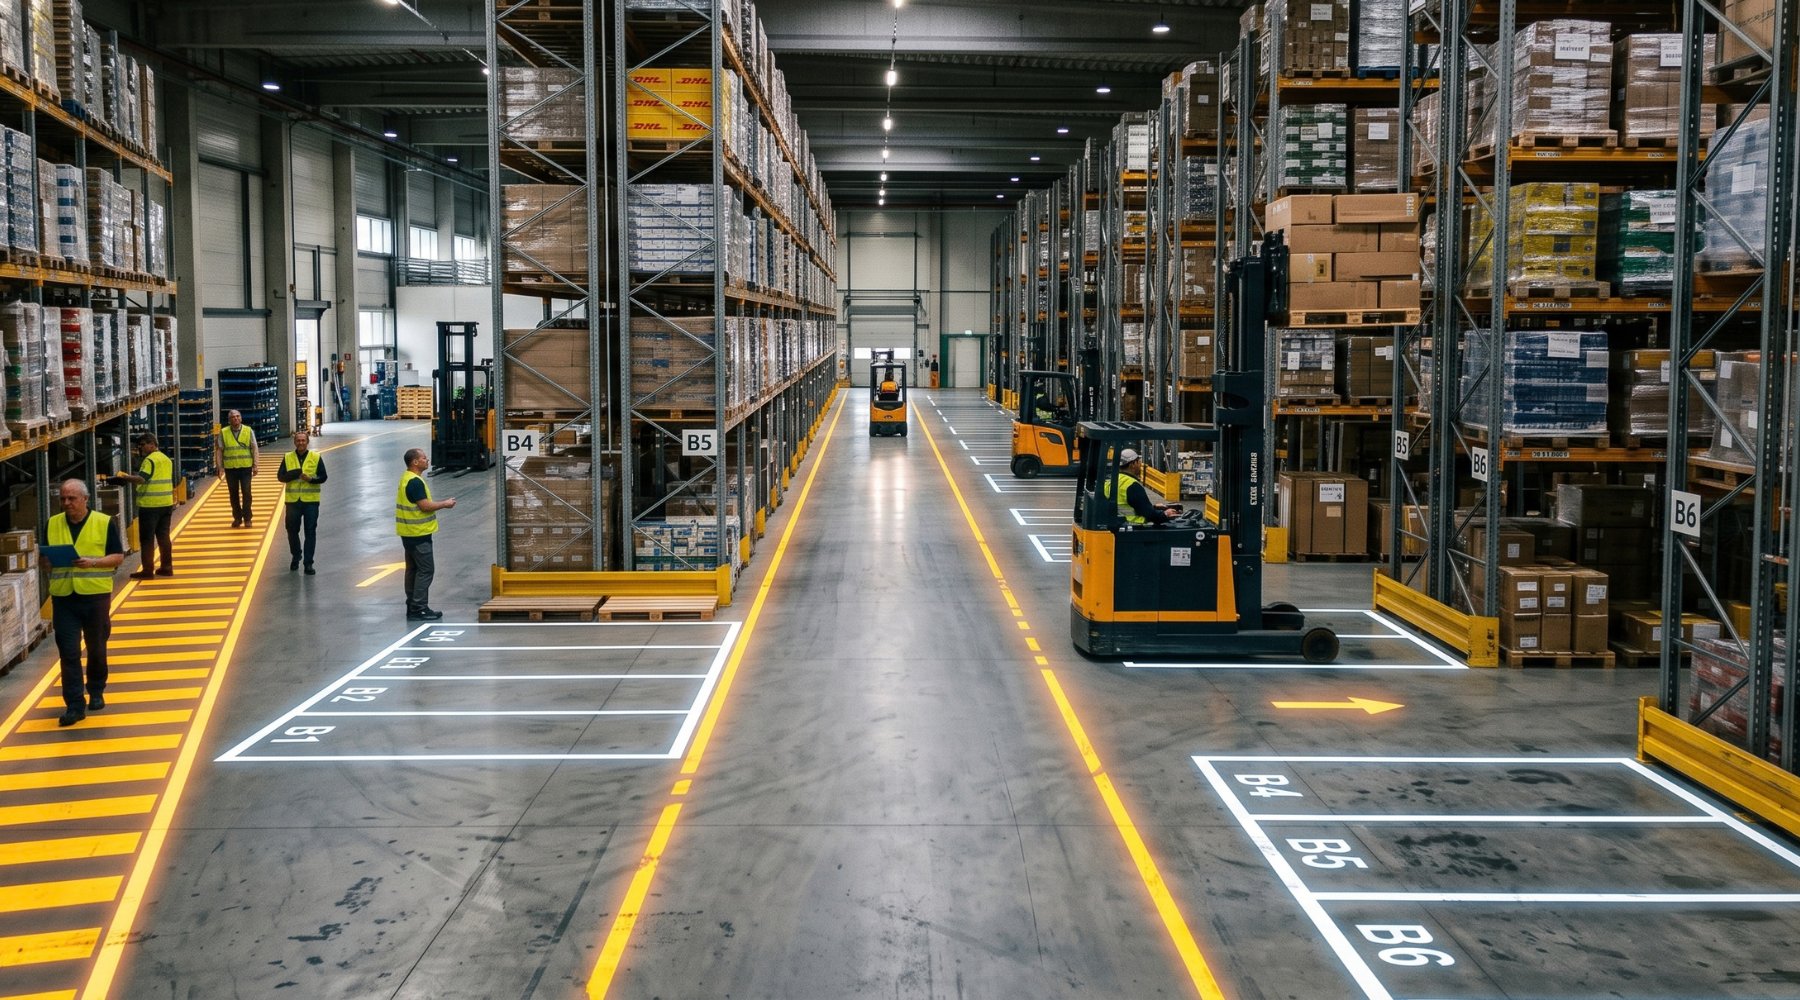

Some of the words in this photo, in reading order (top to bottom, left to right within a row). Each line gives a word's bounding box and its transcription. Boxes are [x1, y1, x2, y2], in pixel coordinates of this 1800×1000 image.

[507, 434, 534, 451] B4
[687, 434, 712, 451] B5
[1396, 435, 1408, 454] B5
[1473, 453, 1487, 475] B6
[1675, 499, 1697, 528] B6
[330, 687, 388, 703] B2
[270, 725, 336, 743] B1
[1234, 774, 1304, 798] B4
[1285, 838, 1369, 869] B5
[1355, 924, 1455, 966] B6
